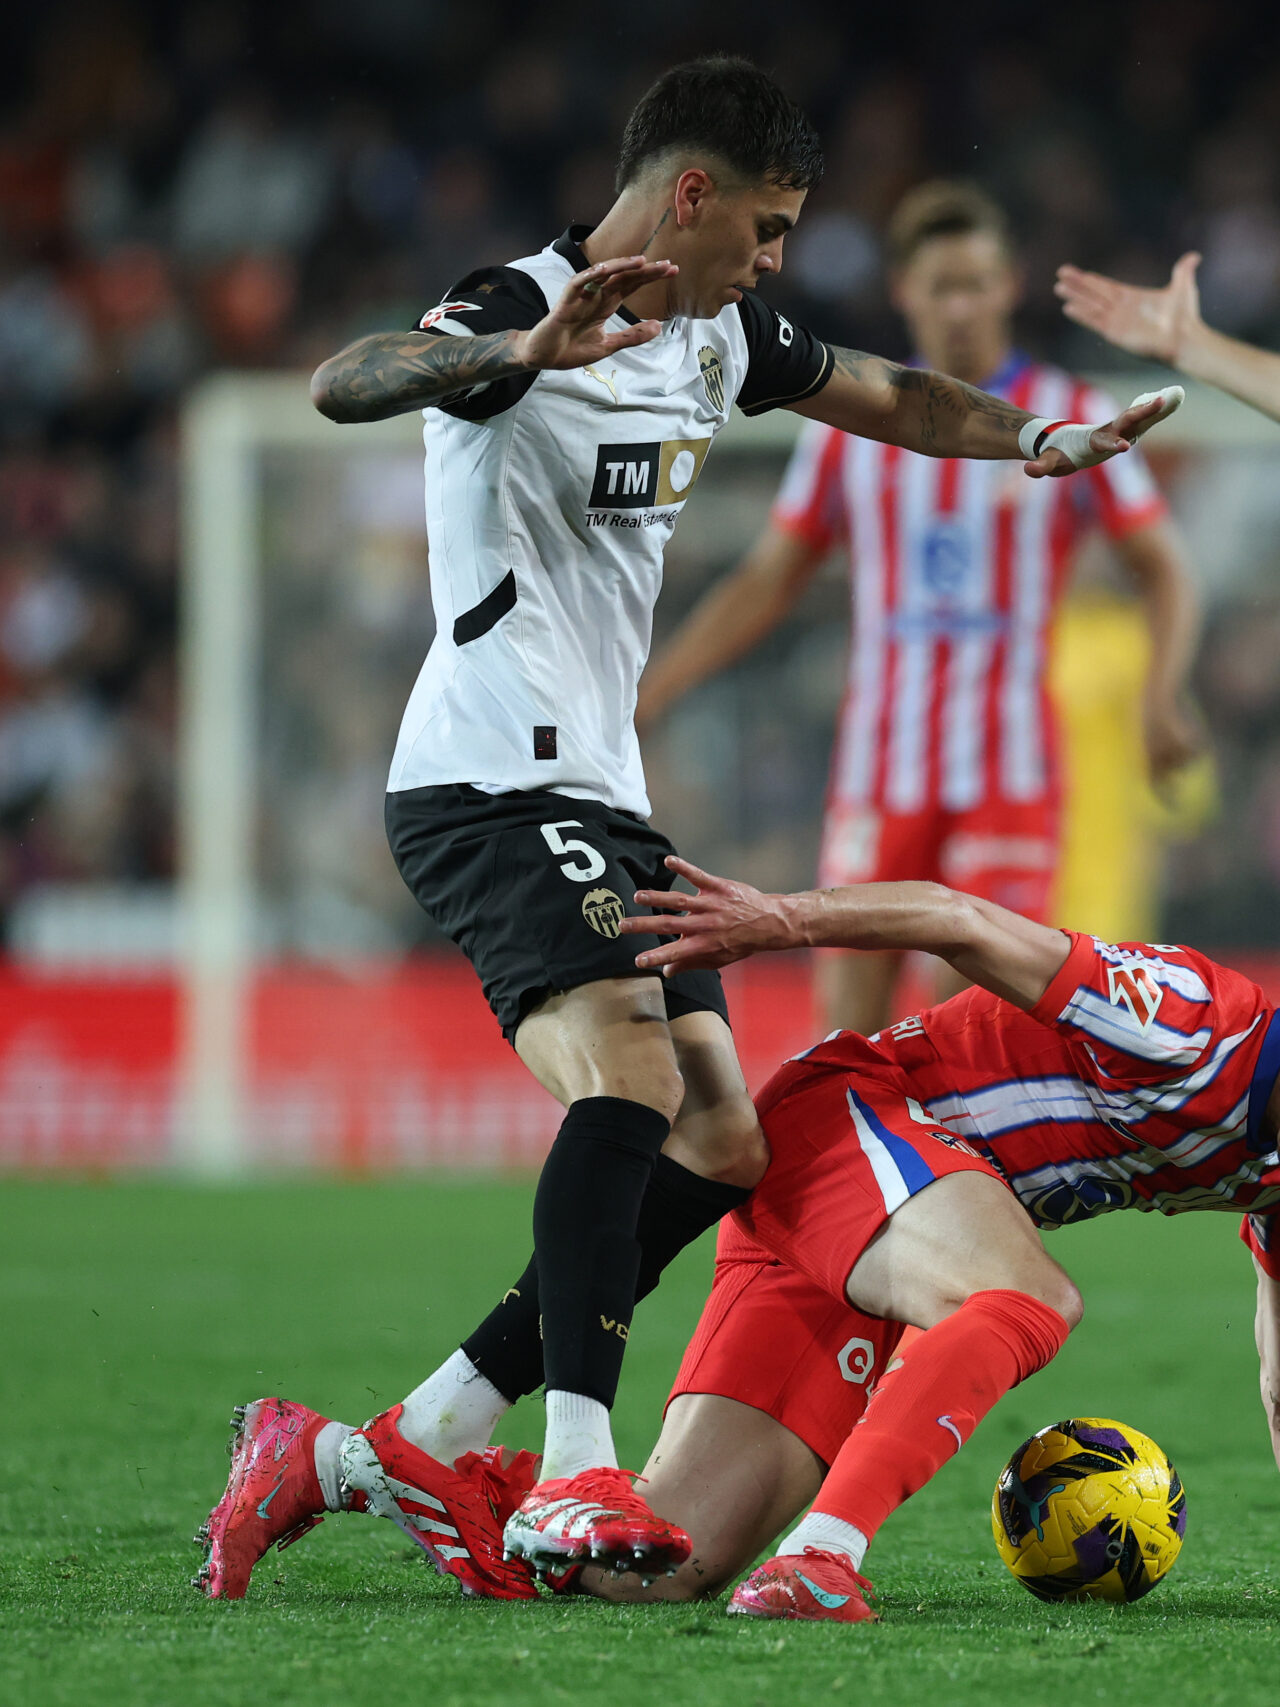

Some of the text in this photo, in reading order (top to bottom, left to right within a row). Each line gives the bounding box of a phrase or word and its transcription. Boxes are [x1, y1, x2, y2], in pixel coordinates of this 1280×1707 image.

[605, 460, 650, 495] TM
[585, 513, 608, 527] TM
[609, 514, 641, 529] Real
[540, 820, 607, 882] 5
